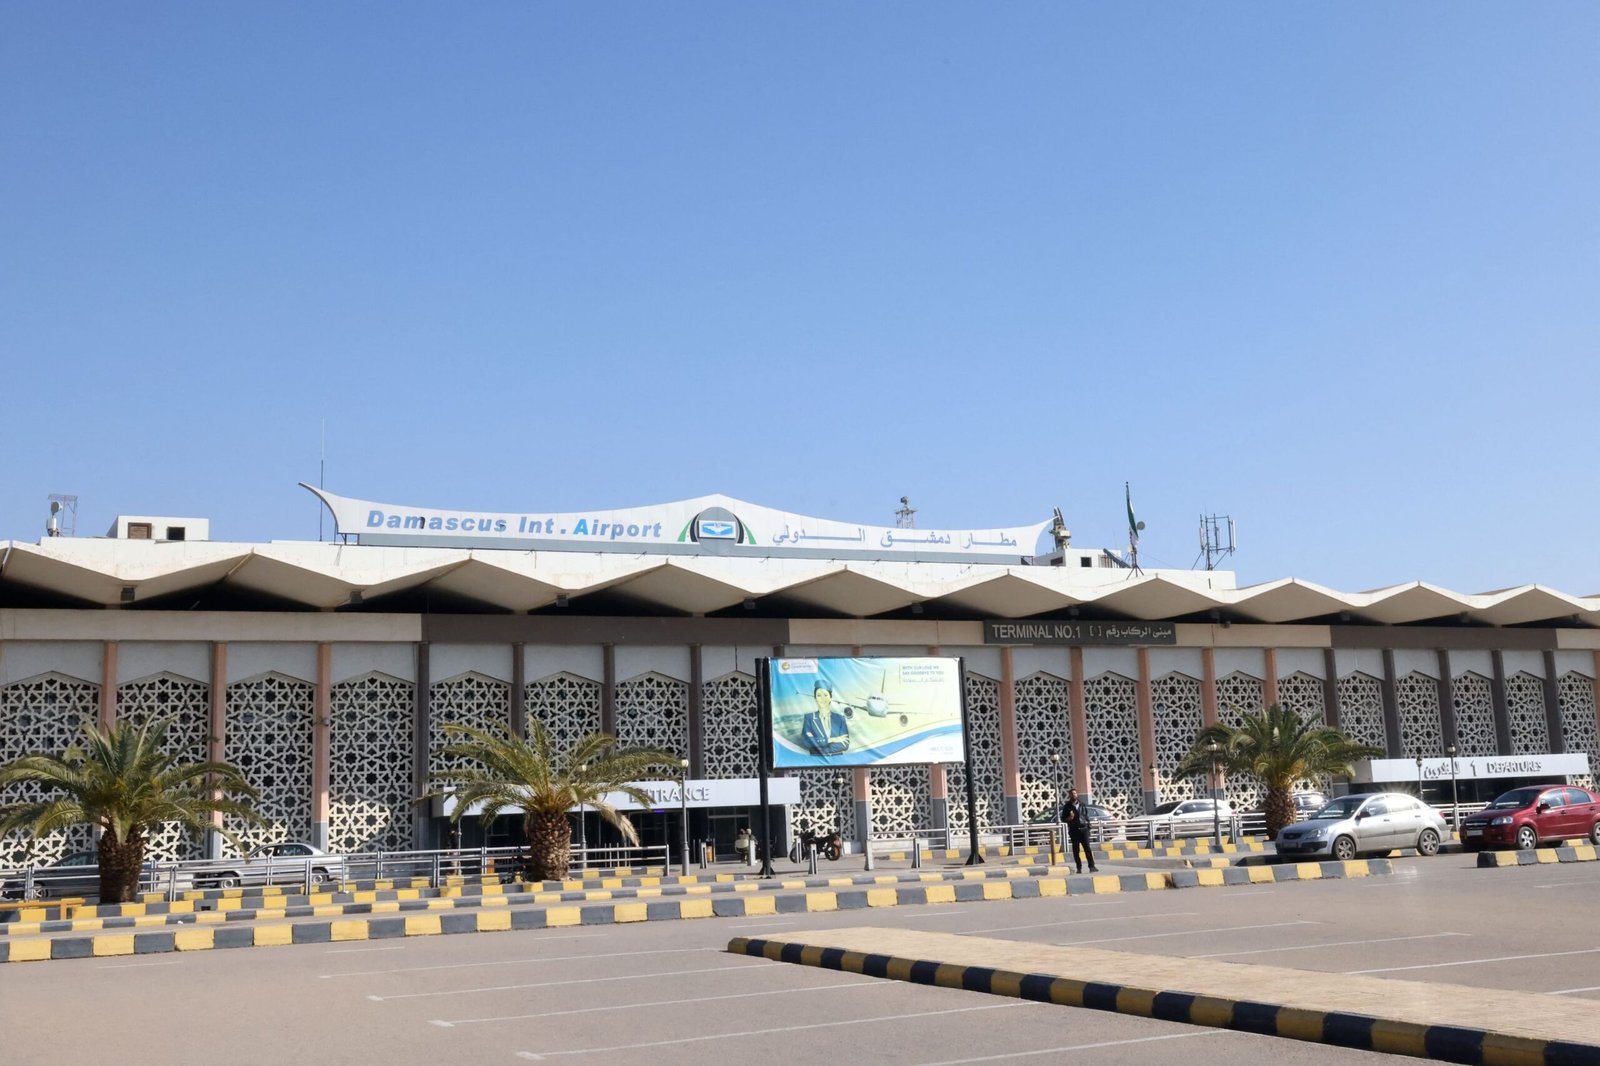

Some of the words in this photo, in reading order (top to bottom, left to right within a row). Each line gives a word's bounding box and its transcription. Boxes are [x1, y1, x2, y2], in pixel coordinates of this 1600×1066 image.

[366, 510, 507, 532] Damascus
[572, 518, 662, 540] Airport
[772, 524, 865, 546] الدولي
[880, 530, 951, 548] دمشق
[962, 532, 1017, 549] مطار
[991, 624, 1052, 639] TERMINAL
[1054, 625, 1081, 639] NO.1
[1105, 624, 1120, 638] رقم
[1486, 760, 1542, 774] DEPARTURES
